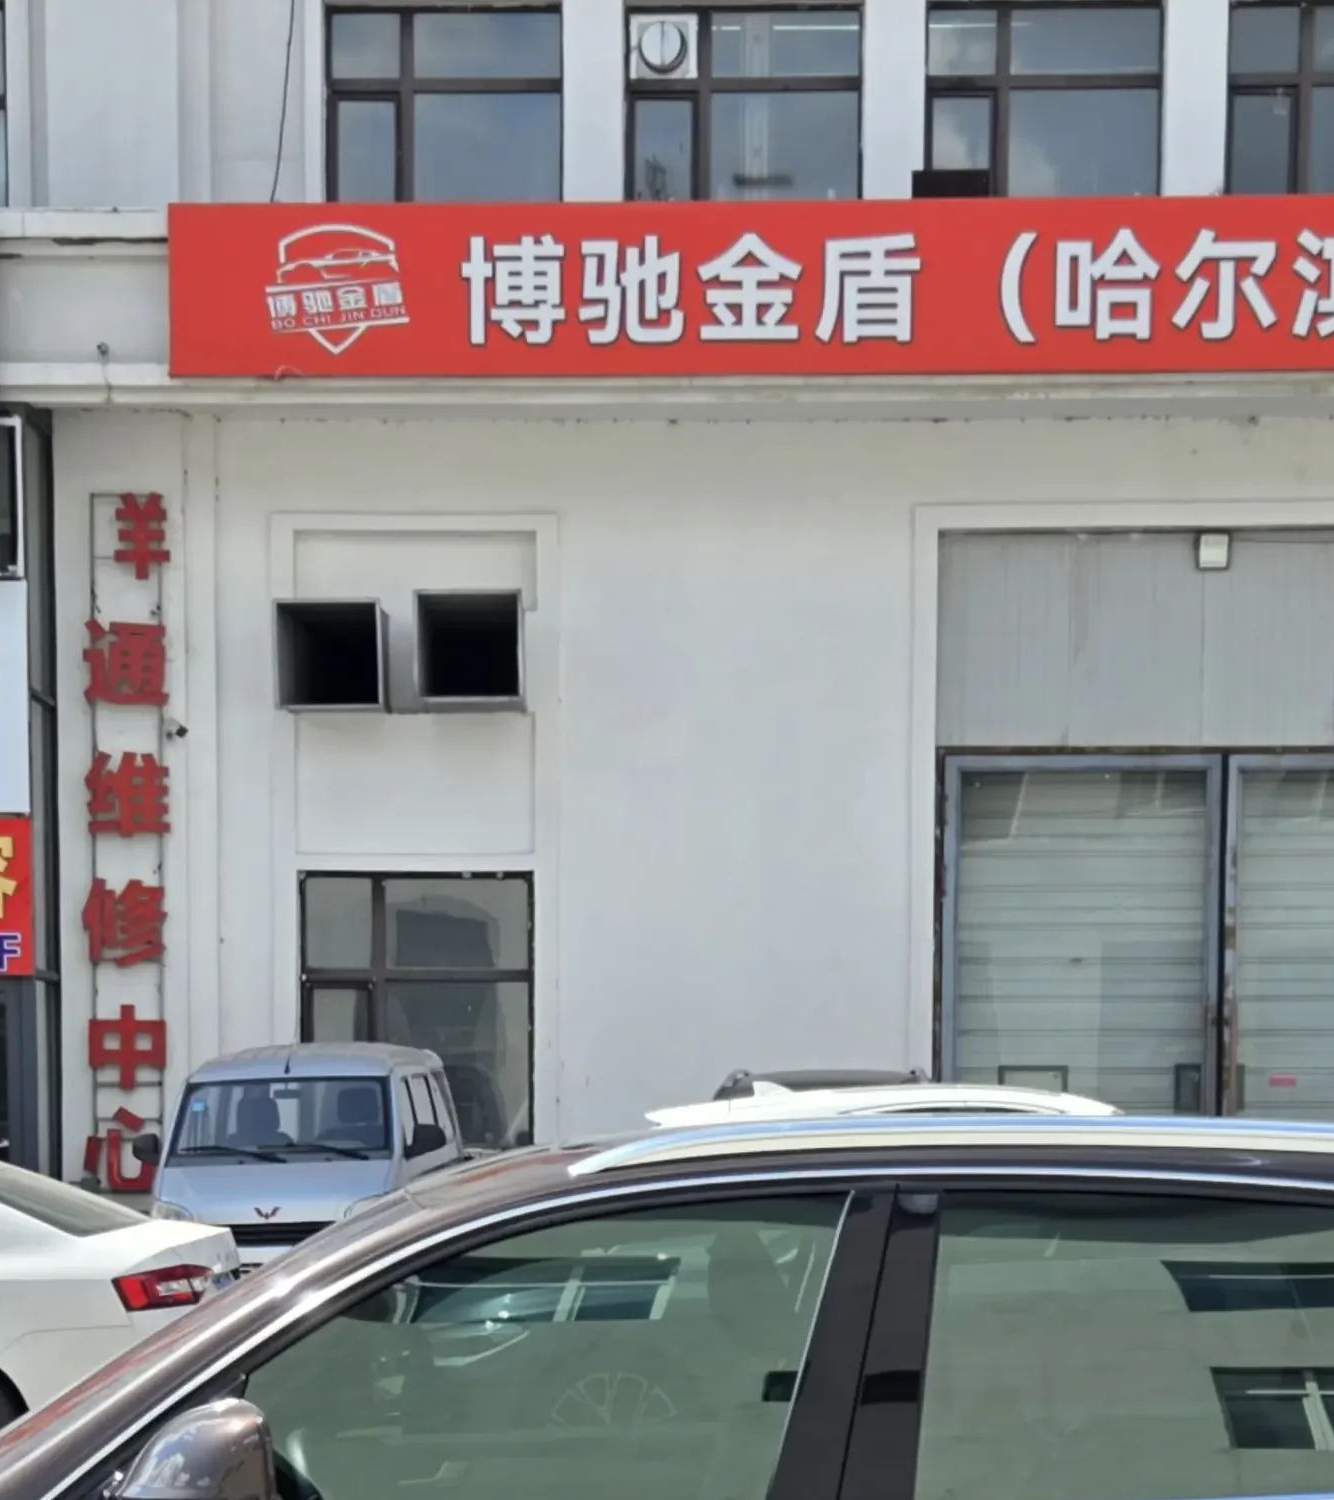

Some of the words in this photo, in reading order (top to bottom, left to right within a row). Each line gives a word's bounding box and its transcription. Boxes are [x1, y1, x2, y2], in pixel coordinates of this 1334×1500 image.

[271, 318, 296, 331] BO
[302, 315, 331, 327] CHI
[339, 311, 365, 323] JIN
